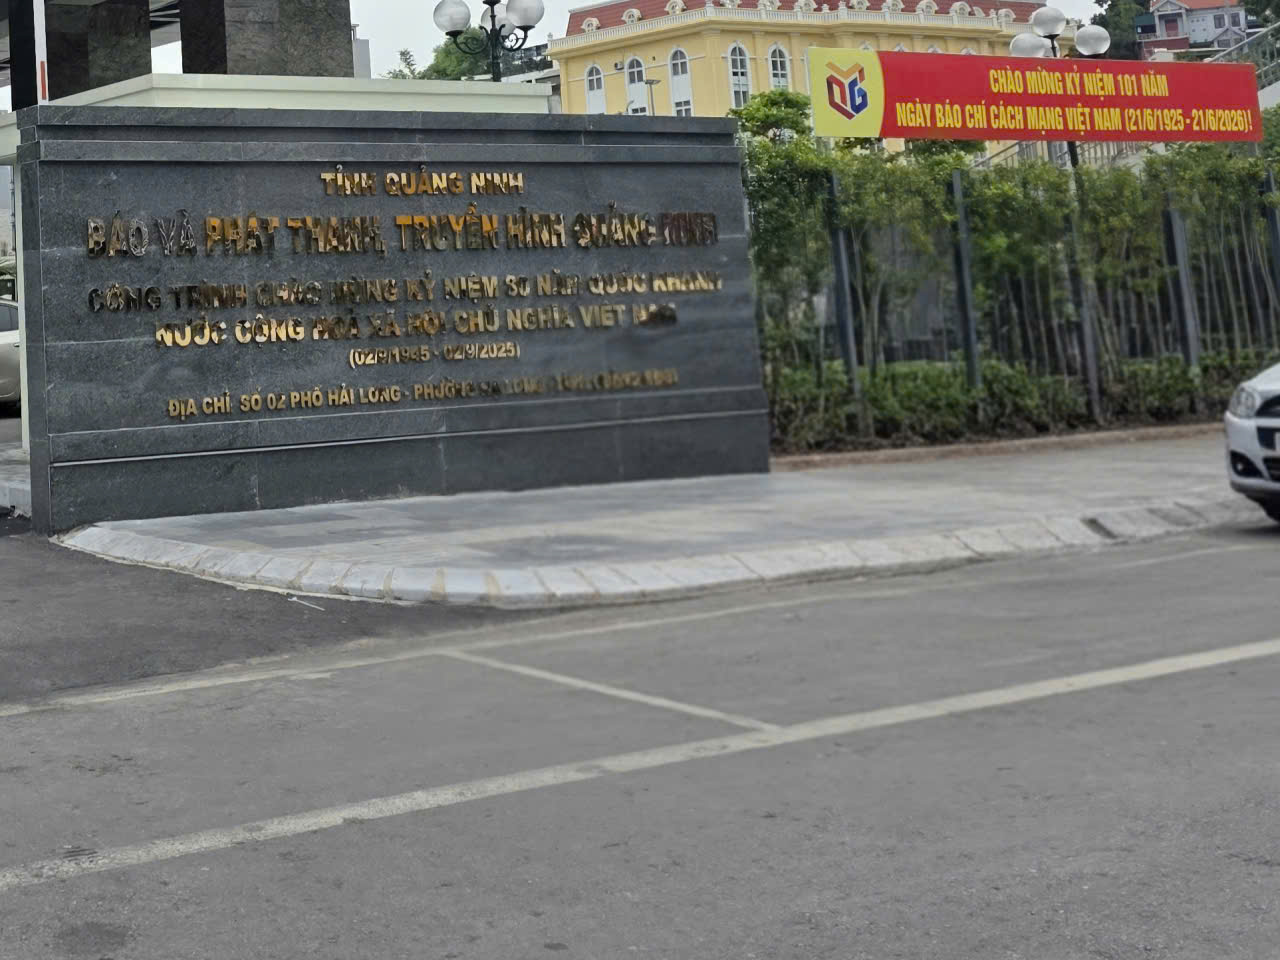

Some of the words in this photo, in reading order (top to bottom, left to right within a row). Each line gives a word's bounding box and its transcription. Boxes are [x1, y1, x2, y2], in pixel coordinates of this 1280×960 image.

[989, 65, 1024, 94] CHÀO
[1025, 66, 1064, 95] MỪNG
[1064, 65, 1080, 95] KỶ
[1083, 68, 1116, 101] NIỆM
[1117, 74, 1138, 96] 101
[1141, 69, 1169, 97] NĂM
[895, 97, 931, 127] NGÀY
[935, 98, 962, 128] BÁO
[965, 100, 988, 129] CHÍ
[989, 100, 1024, 129] CÁCH
[1026, 106, 1064, 135] MẠNG
[1065, 102, 1091, 136] VIỆT
[1093, 107, 1122, 131] NAM
[320, 164, 376, 195] TỈNH
[384, 165, 464, 196] QUẢNG
[470, 172, 524, 194] NINH
[87, 210, 149, 257] BÁO
[156, 208, 197, 257] VÀ
[395, 201, 500, 251] TRUYỀN
[505, 206, 567, 249] HÌNH
[573, 200, 656, 248] QUẢNG
[88, 282, 162, 312] CÔNG
[407, 268, 435, 301] KỶ
[444, 272, 499, 303] NIỆM
[156, 311, 228, 347] NƯỚC
[234, 313, 305, 348] CỘNG
[454, 303, 500, 333] CHỦ
[506, 303, 576, 330] NGHĨA
[168, 398, 197, 420] ĐỊA
[239, 386, 262, 412] SỐ
[266, 393, 286, 410] 02
[327, 383, 355, 406] HẢI
[359, 384, 401, 404] LONG
